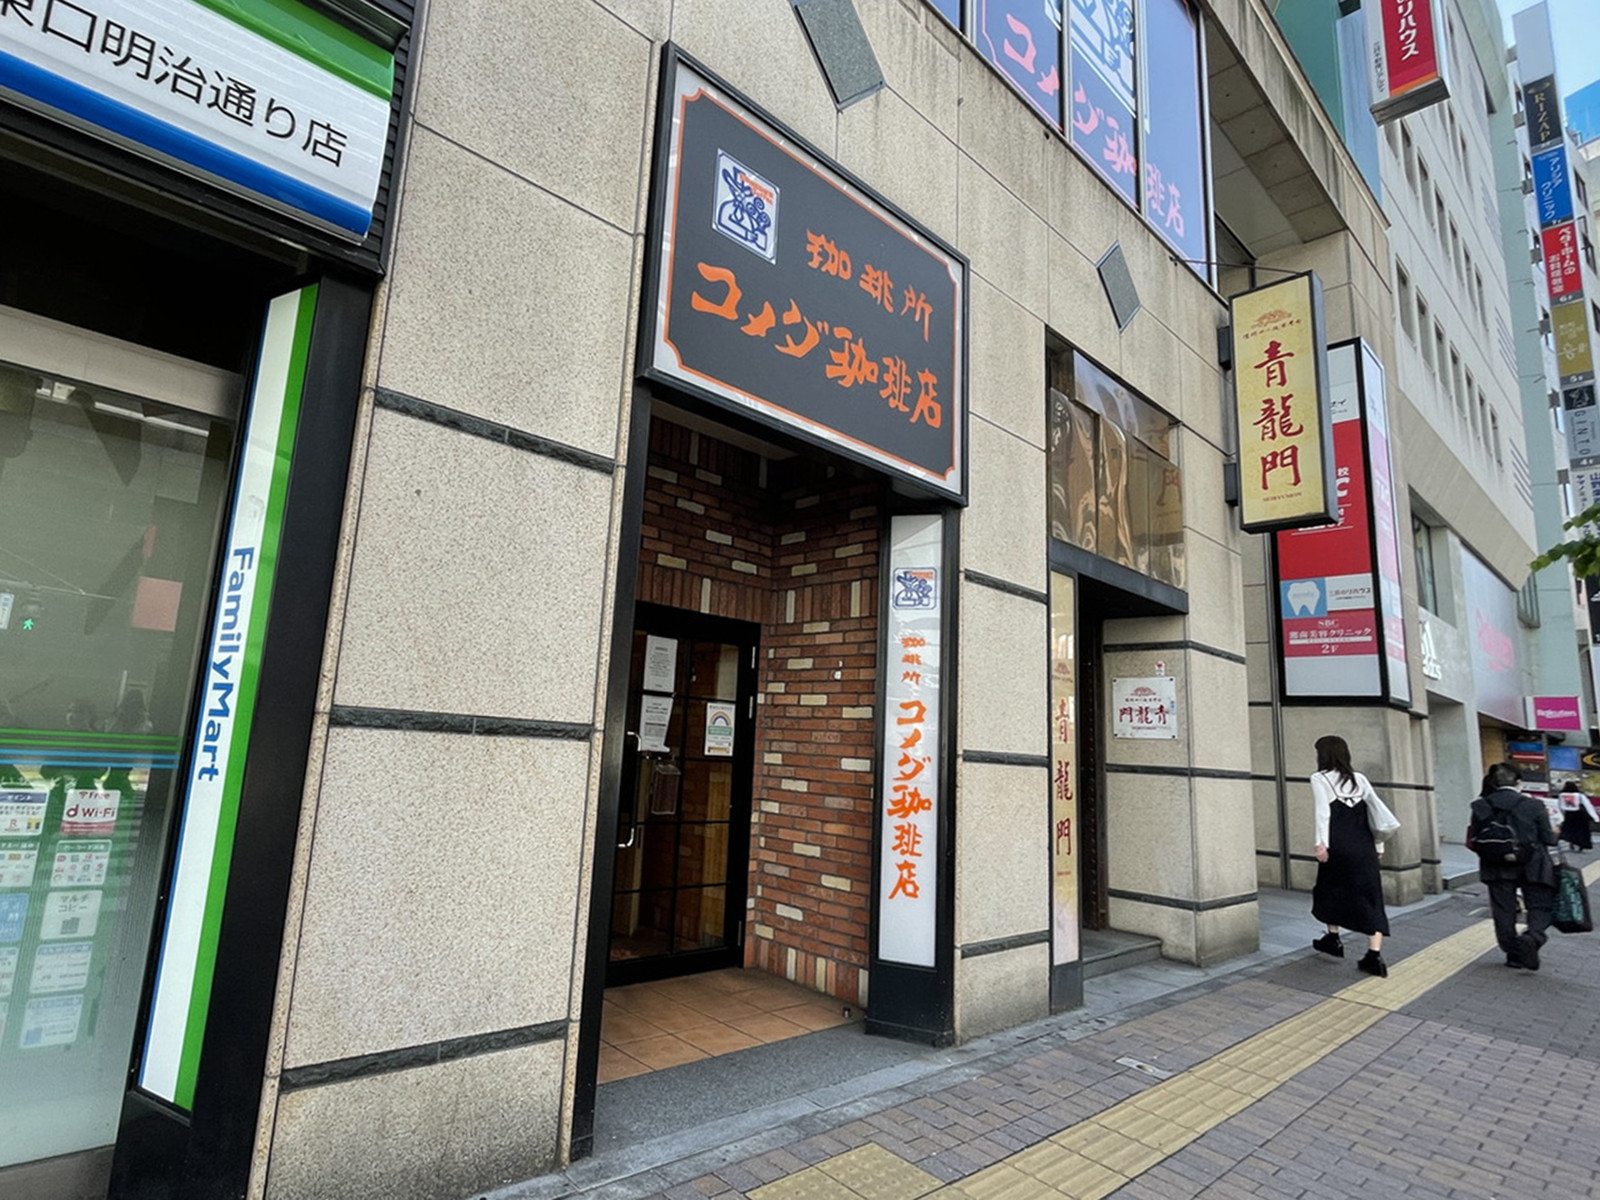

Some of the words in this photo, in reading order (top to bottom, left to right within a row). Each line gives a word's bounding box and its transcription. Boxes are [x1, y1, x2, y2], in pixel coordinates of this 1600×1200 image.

[691, 262, 943, 429] コメダ珈琲店
[805, 230, 933, 343] 珈琲所
[1252, 339, 1305, 491] 青龍門
[198, 546, 255, 782] FamilyMart
[886, 699, 932, 899] コメダ珈琲店
[1053, 698, 1074, 857] 青龍門
